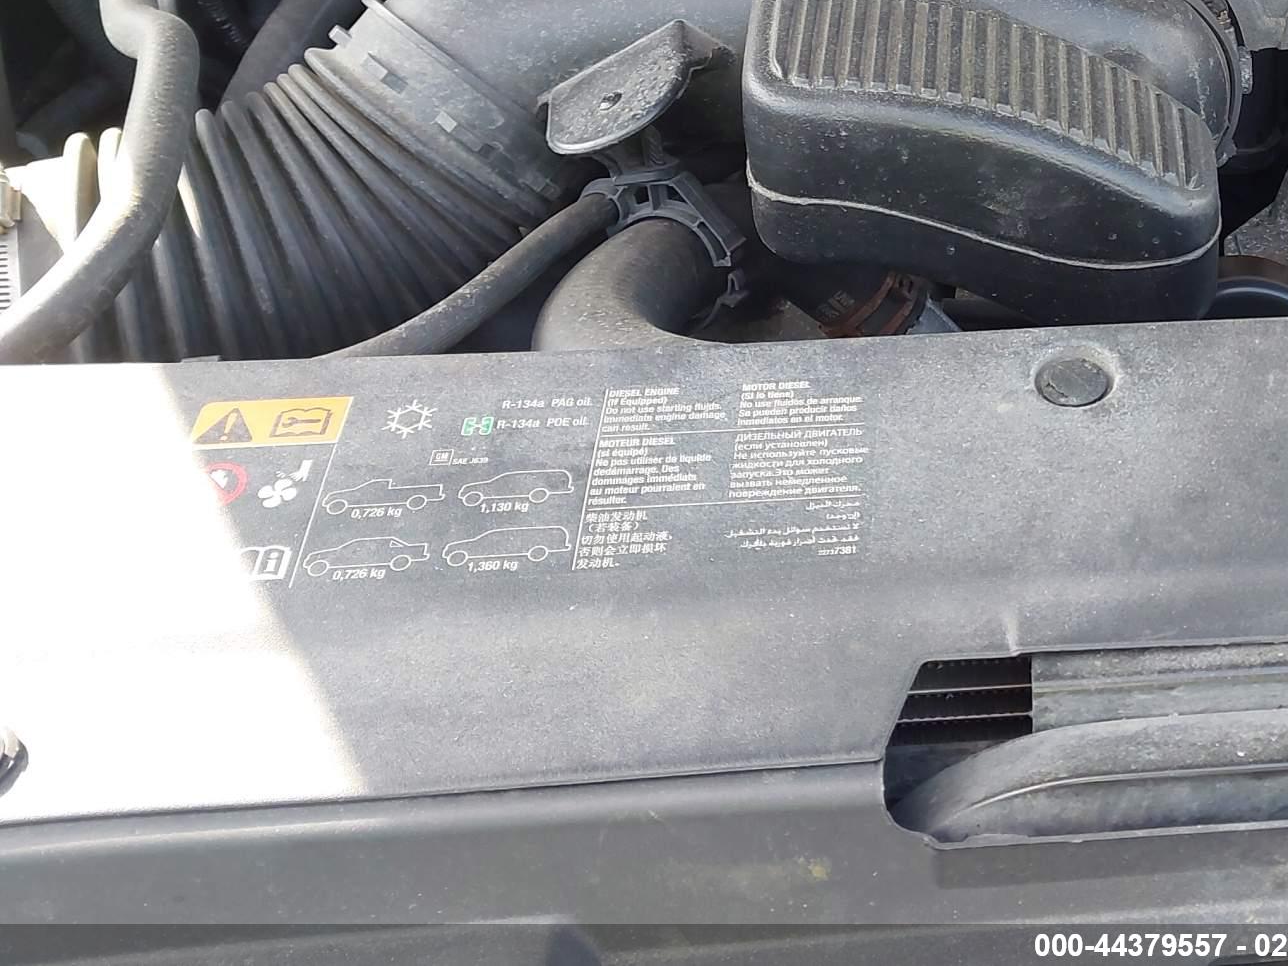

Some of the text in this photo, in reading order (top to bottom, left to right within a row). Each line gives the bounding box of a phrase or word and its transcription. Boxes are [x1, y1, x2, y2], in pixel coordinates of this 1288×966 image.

[778, 381, 811, 389] DIESEL
[609, 388, 680, 397] DIESEL ENGINE
[502, 399, 544, 410] R-134a
[552, 398, 573, 408] PAG
[620, 397, 668, 406] Equipped)
[656, 404, 692, 412] starting
[694, 402, 722, 411] fluids.
[773, 399, 804, 407] fluidos
[789, 407, 827, 416] producir
[655, 414, 686, 422] engine
[496, 419, 540, 430] R-134a
[546, 418, 570, 427] POE
[735, 428, 863, 442] ДИЗЕЛЬНЫЙ ДВИГАТЕЛЬ
[599, 440, 640, 448] MOTEUR
[734, 439, 828, 451] (если установлен)
[612, 448, 648, 457] équipé)
[750, 450, 816, 458] используйте
[595, 459, 608, 467] Ne
[611, 459, 628, 467] pas
[631, 457, 662, 465] utiliser
[679, 454, 712, 463] liquide
[731, 461, 783, 469] жидкости
[806, 456, 863, 465] холодного
[795, 468, 829, 476] может
[592, 474, 697, 485] dommages immédiats
[730, 476, 848, 488] вызвать немедленное
[641, 484, 691, 494] pourraient
[729, 485, 861, 498] повреждение двигателя.
[588, 497, 627, 505] résulter.
[480, 501, 530, 513] 1,130 kg
[350, 507, 402, 519] 0,726 kg
[585, 510, 648, 523] 柴油发动机
[579, 543, 667, 556] 否则会立即损坏
[467, 559, 519, 572] 1,360 kg
[332, 568, 385, 580] 0,726 kg
